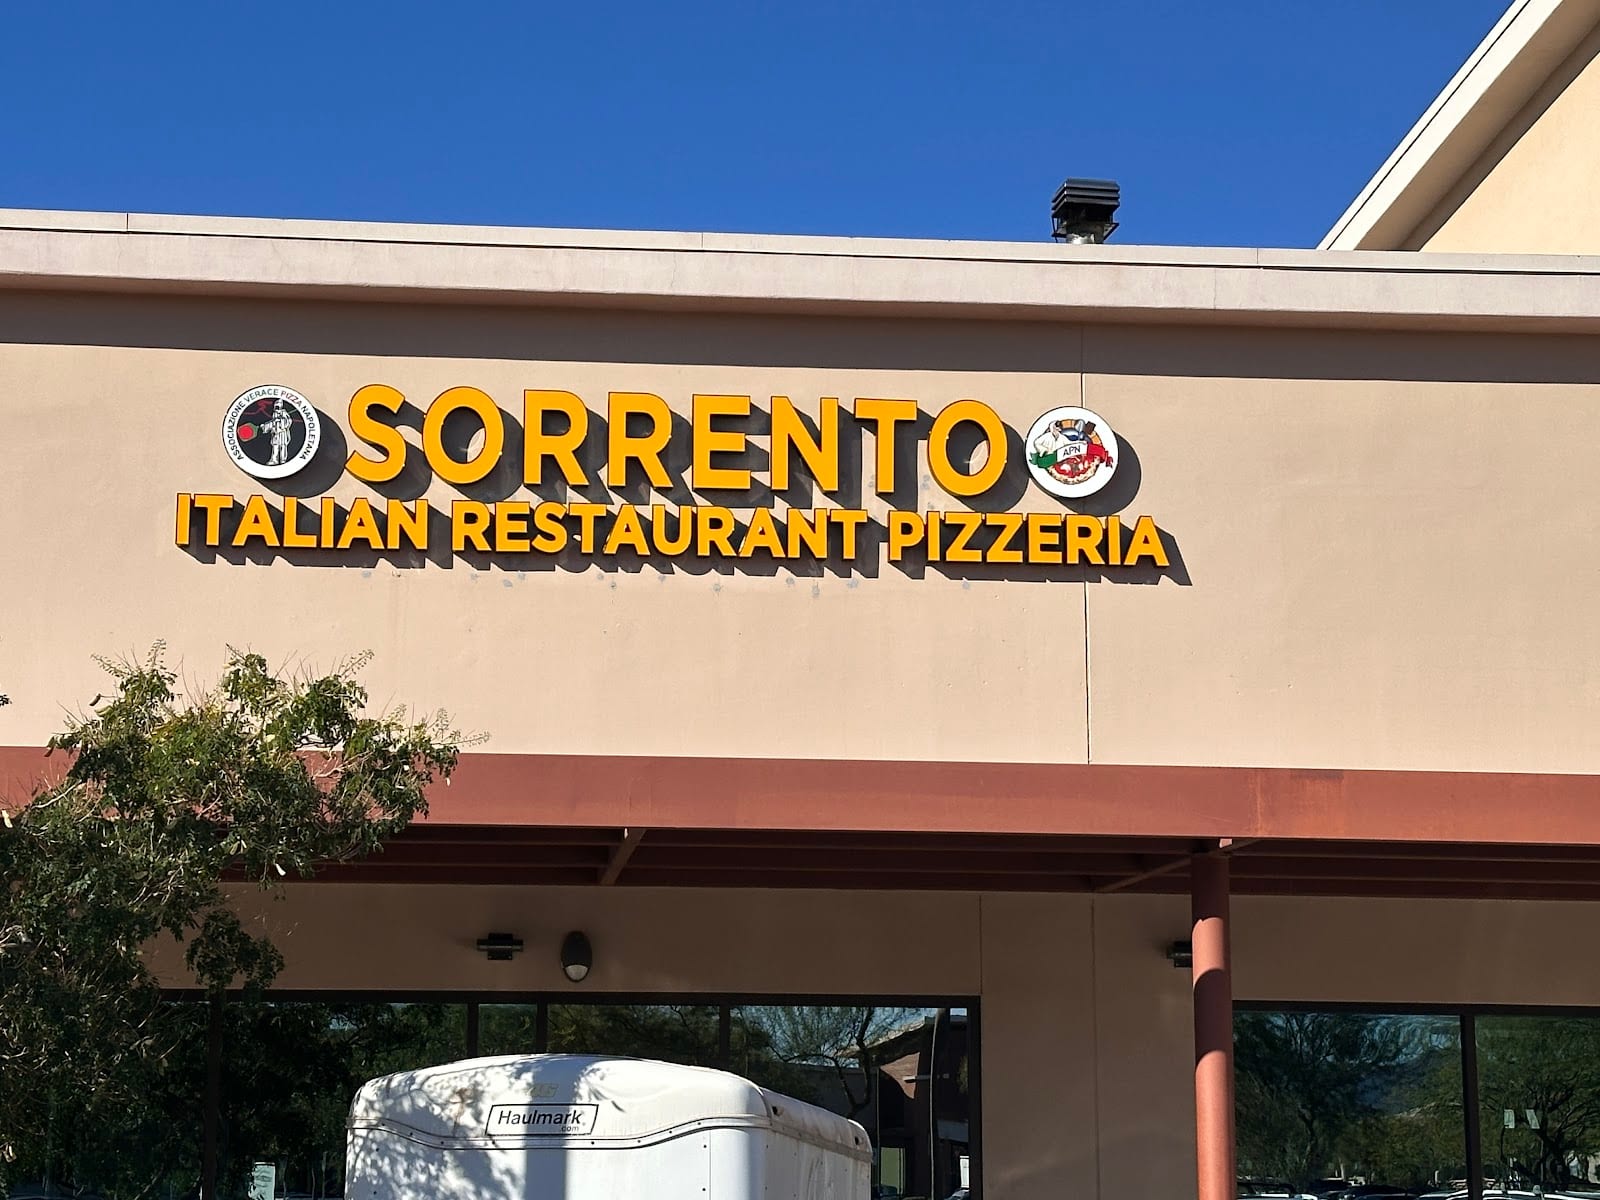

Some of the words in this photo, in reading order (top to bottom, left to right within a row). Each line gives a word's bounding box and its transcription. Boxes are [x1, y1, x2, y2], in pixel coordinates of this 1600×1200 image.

[227, 401, 245, 460] ASSOCIAZIONE
[244, 389, 279, 402] VERACE
[280, 391, 302, 406] PIZZA
[299, 405, 316, 460] NAPOLETANA
[346, 384, 1008, 497] SORRENTO
[1062, 445, 1081, 457] APN
[177, 494, 428, 550] ITALIAN
[452, 500, 869, 561] RESTAURANT
[889, 509, 1169, 569] PIZZERIA
[498, 1109, 583, 1125] Haulmark
